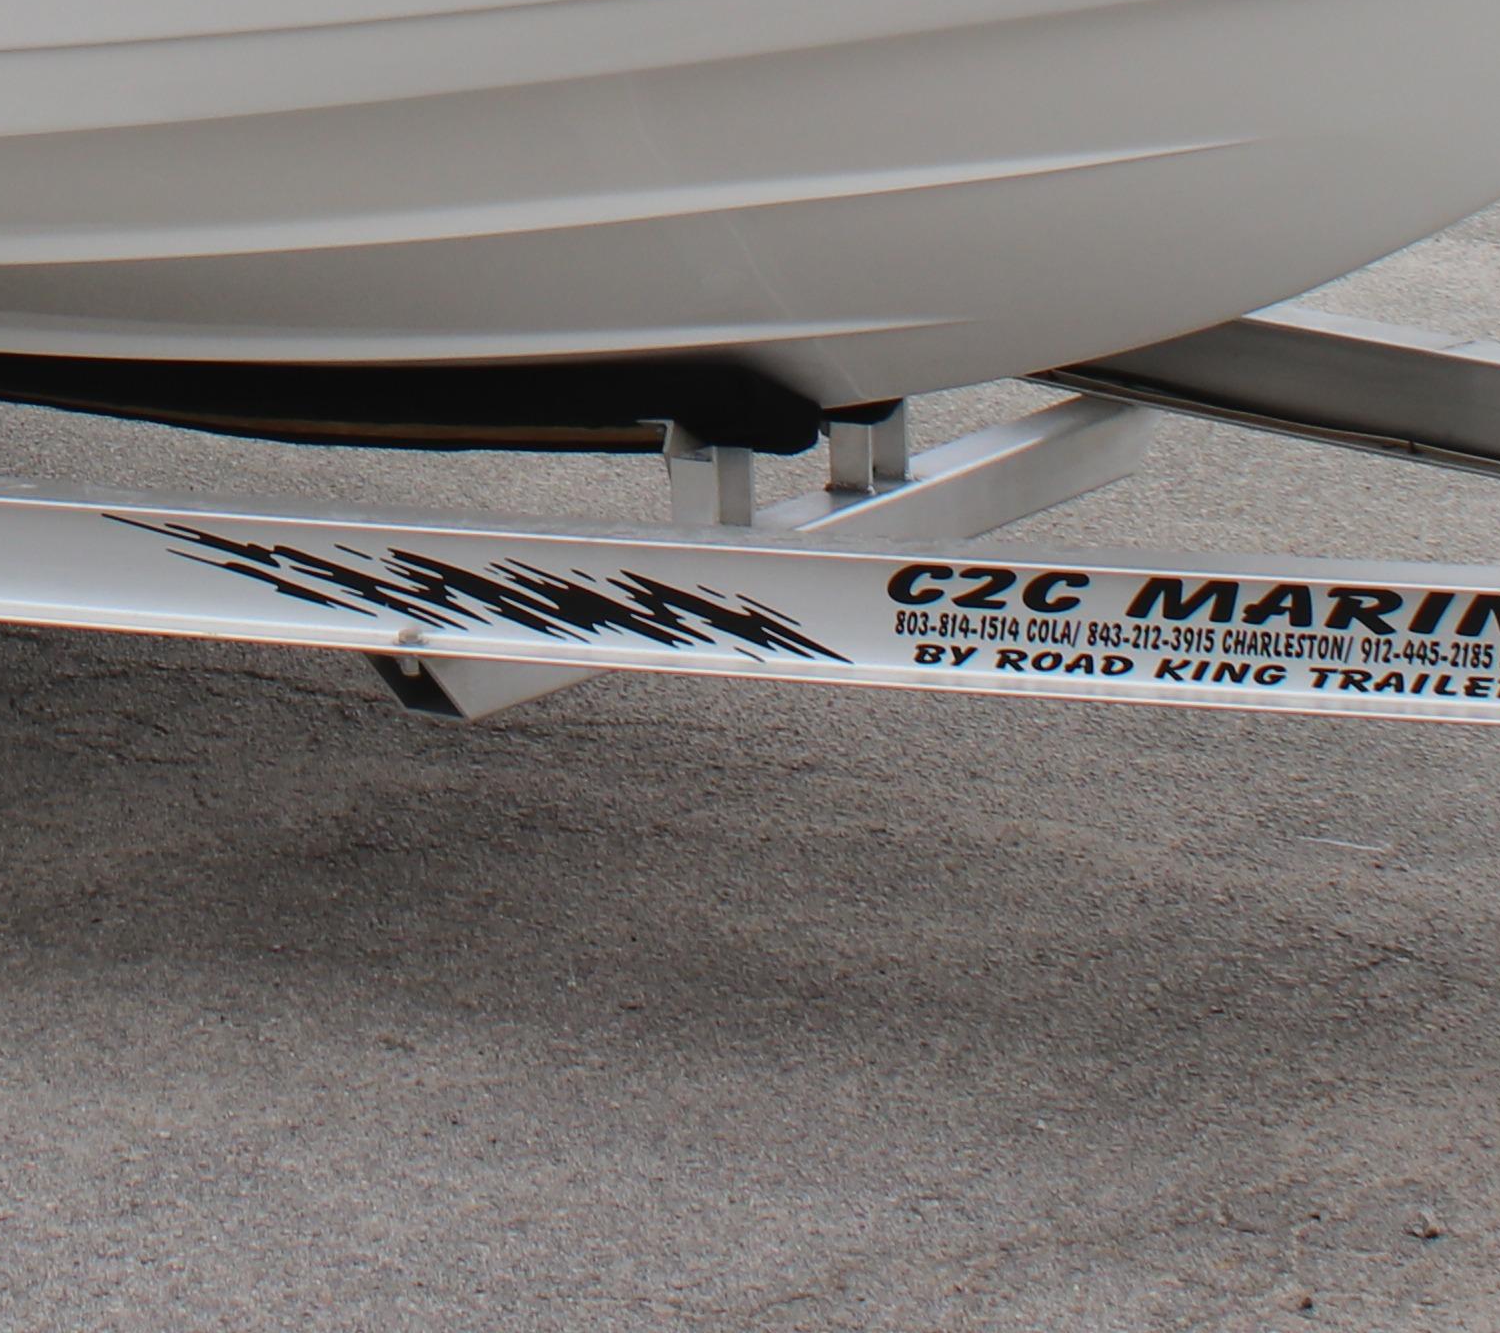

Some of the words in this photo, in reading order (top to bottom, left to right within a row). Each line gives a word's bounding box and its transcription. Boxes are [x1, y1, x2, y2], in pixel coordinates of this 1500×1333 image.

[887, 563, 1091, 613] C2C
[894, 610, 1020, 642] 803-814-1514
[1026, 617, 1082, 648] COLA/
[1086, 621, 1216, 654] 843-212-3915
[1221, 629, 1355, 664] CHARLESTON/
[1361, 636, 1495, 670] 912-445-2185
[913, 643, 979, 667] BY
[995, 648, 1135, 676] ROAD
[1153, 657, 1288, 686] KING
